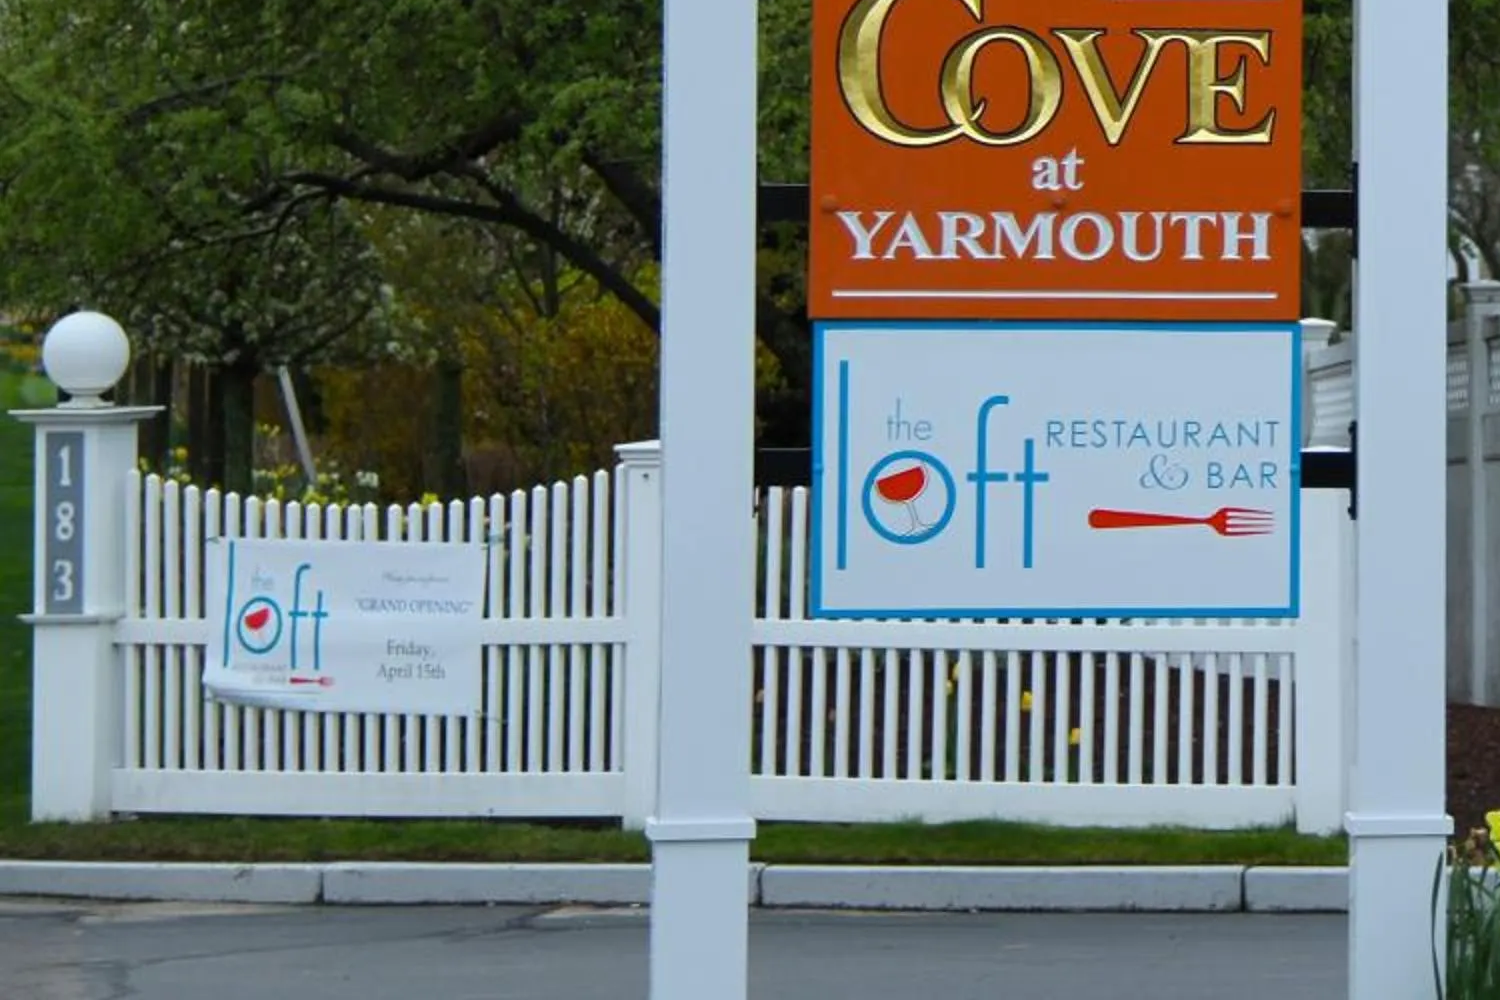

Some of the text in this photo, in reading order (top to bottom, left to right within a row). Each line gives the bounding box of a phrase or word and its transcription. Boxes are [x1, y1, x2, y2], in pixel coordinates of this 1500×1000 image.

[1032, 149, 1085, 191] at
[837, 211, 1273, 262] YARMOUTH
[886, 396, 932, 441] the
[1046, 420, 1280, 449] RESTAURANT
[836, 360, 1049, 570] loft
[1139, 453, 1279, 490] & BAR
[53, 445, 75, 601] 183
[222, 540, 329, 670] loft
[376, 663, 414, 683] April
